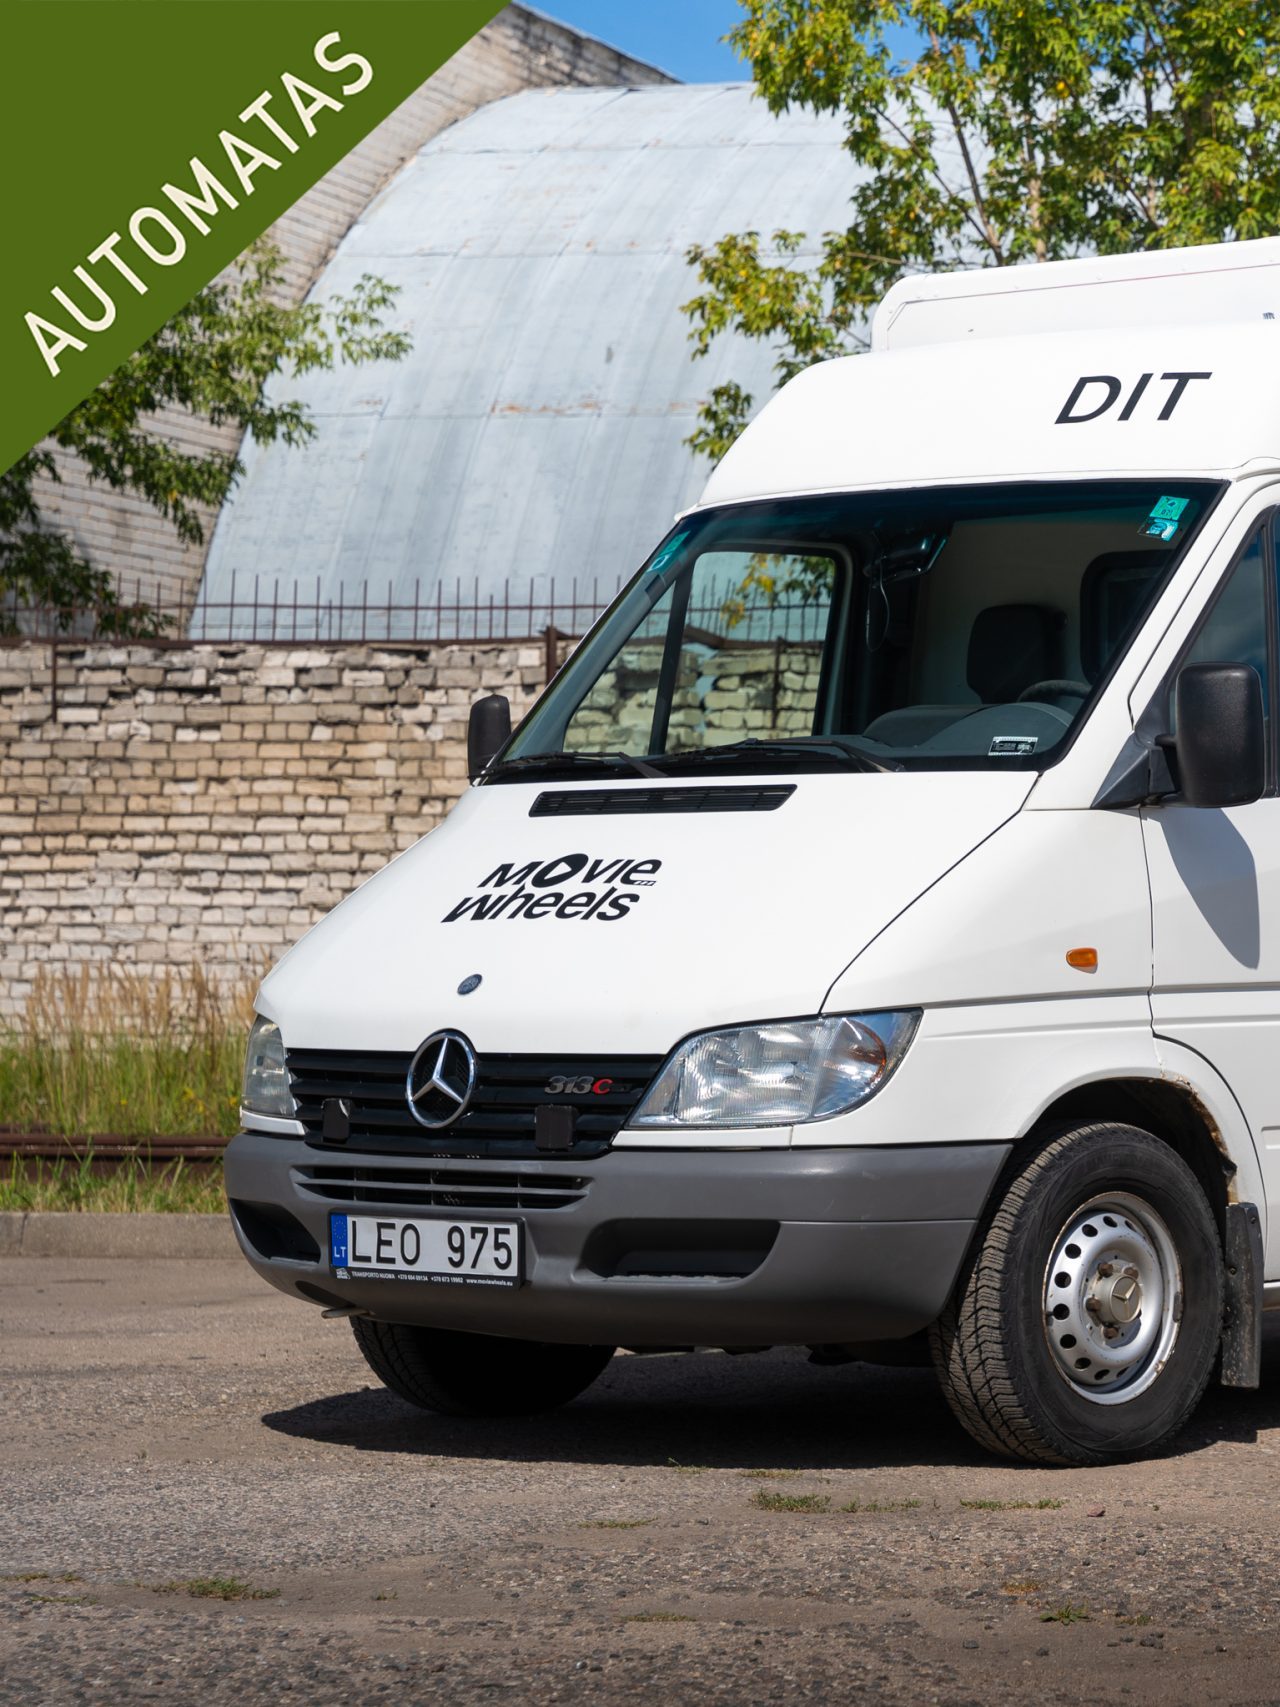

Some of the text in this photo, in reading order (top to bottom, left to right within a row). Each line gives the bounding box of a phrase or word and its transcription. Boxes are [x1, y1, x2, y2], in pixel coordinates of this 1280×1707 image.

[1054, 371, 1213, 424] DIT
[333, 1246, 347, 1258] LT
[351, 1220, 512, 1270] LEO 975
